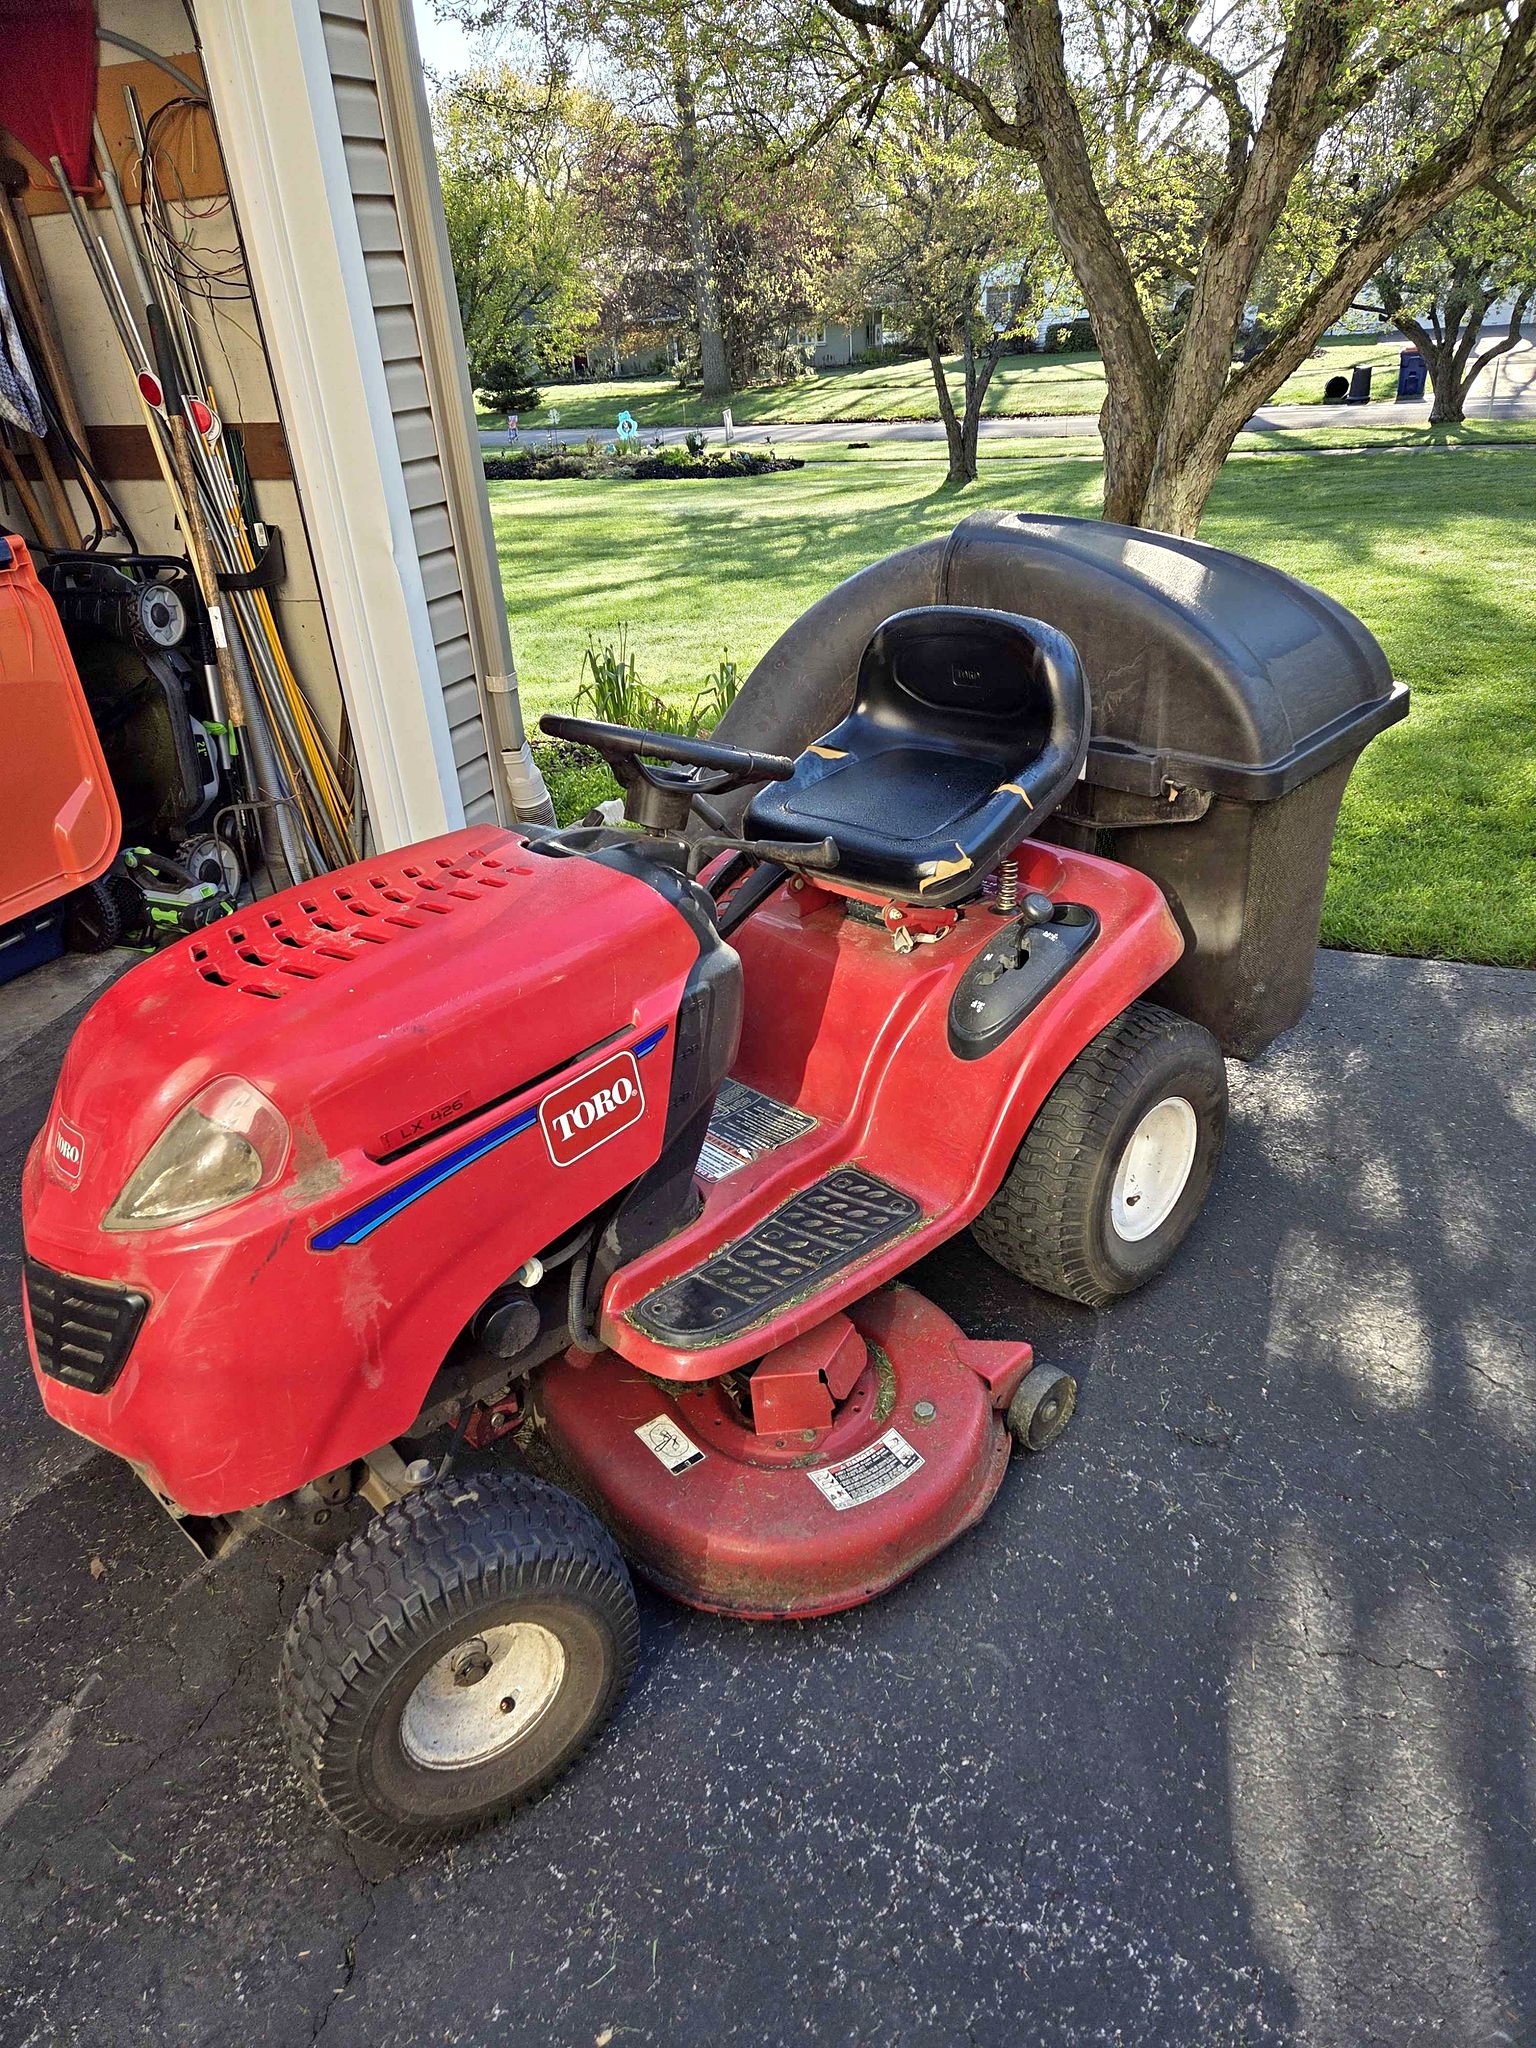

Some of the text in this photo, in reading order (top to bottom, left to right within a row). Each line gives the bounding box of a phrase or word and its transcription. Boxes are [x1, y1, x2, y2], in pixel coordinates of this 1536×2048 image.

[400, 1099, 463, 1139] LX 426
[552, 1077, 633, 1142] TORO
